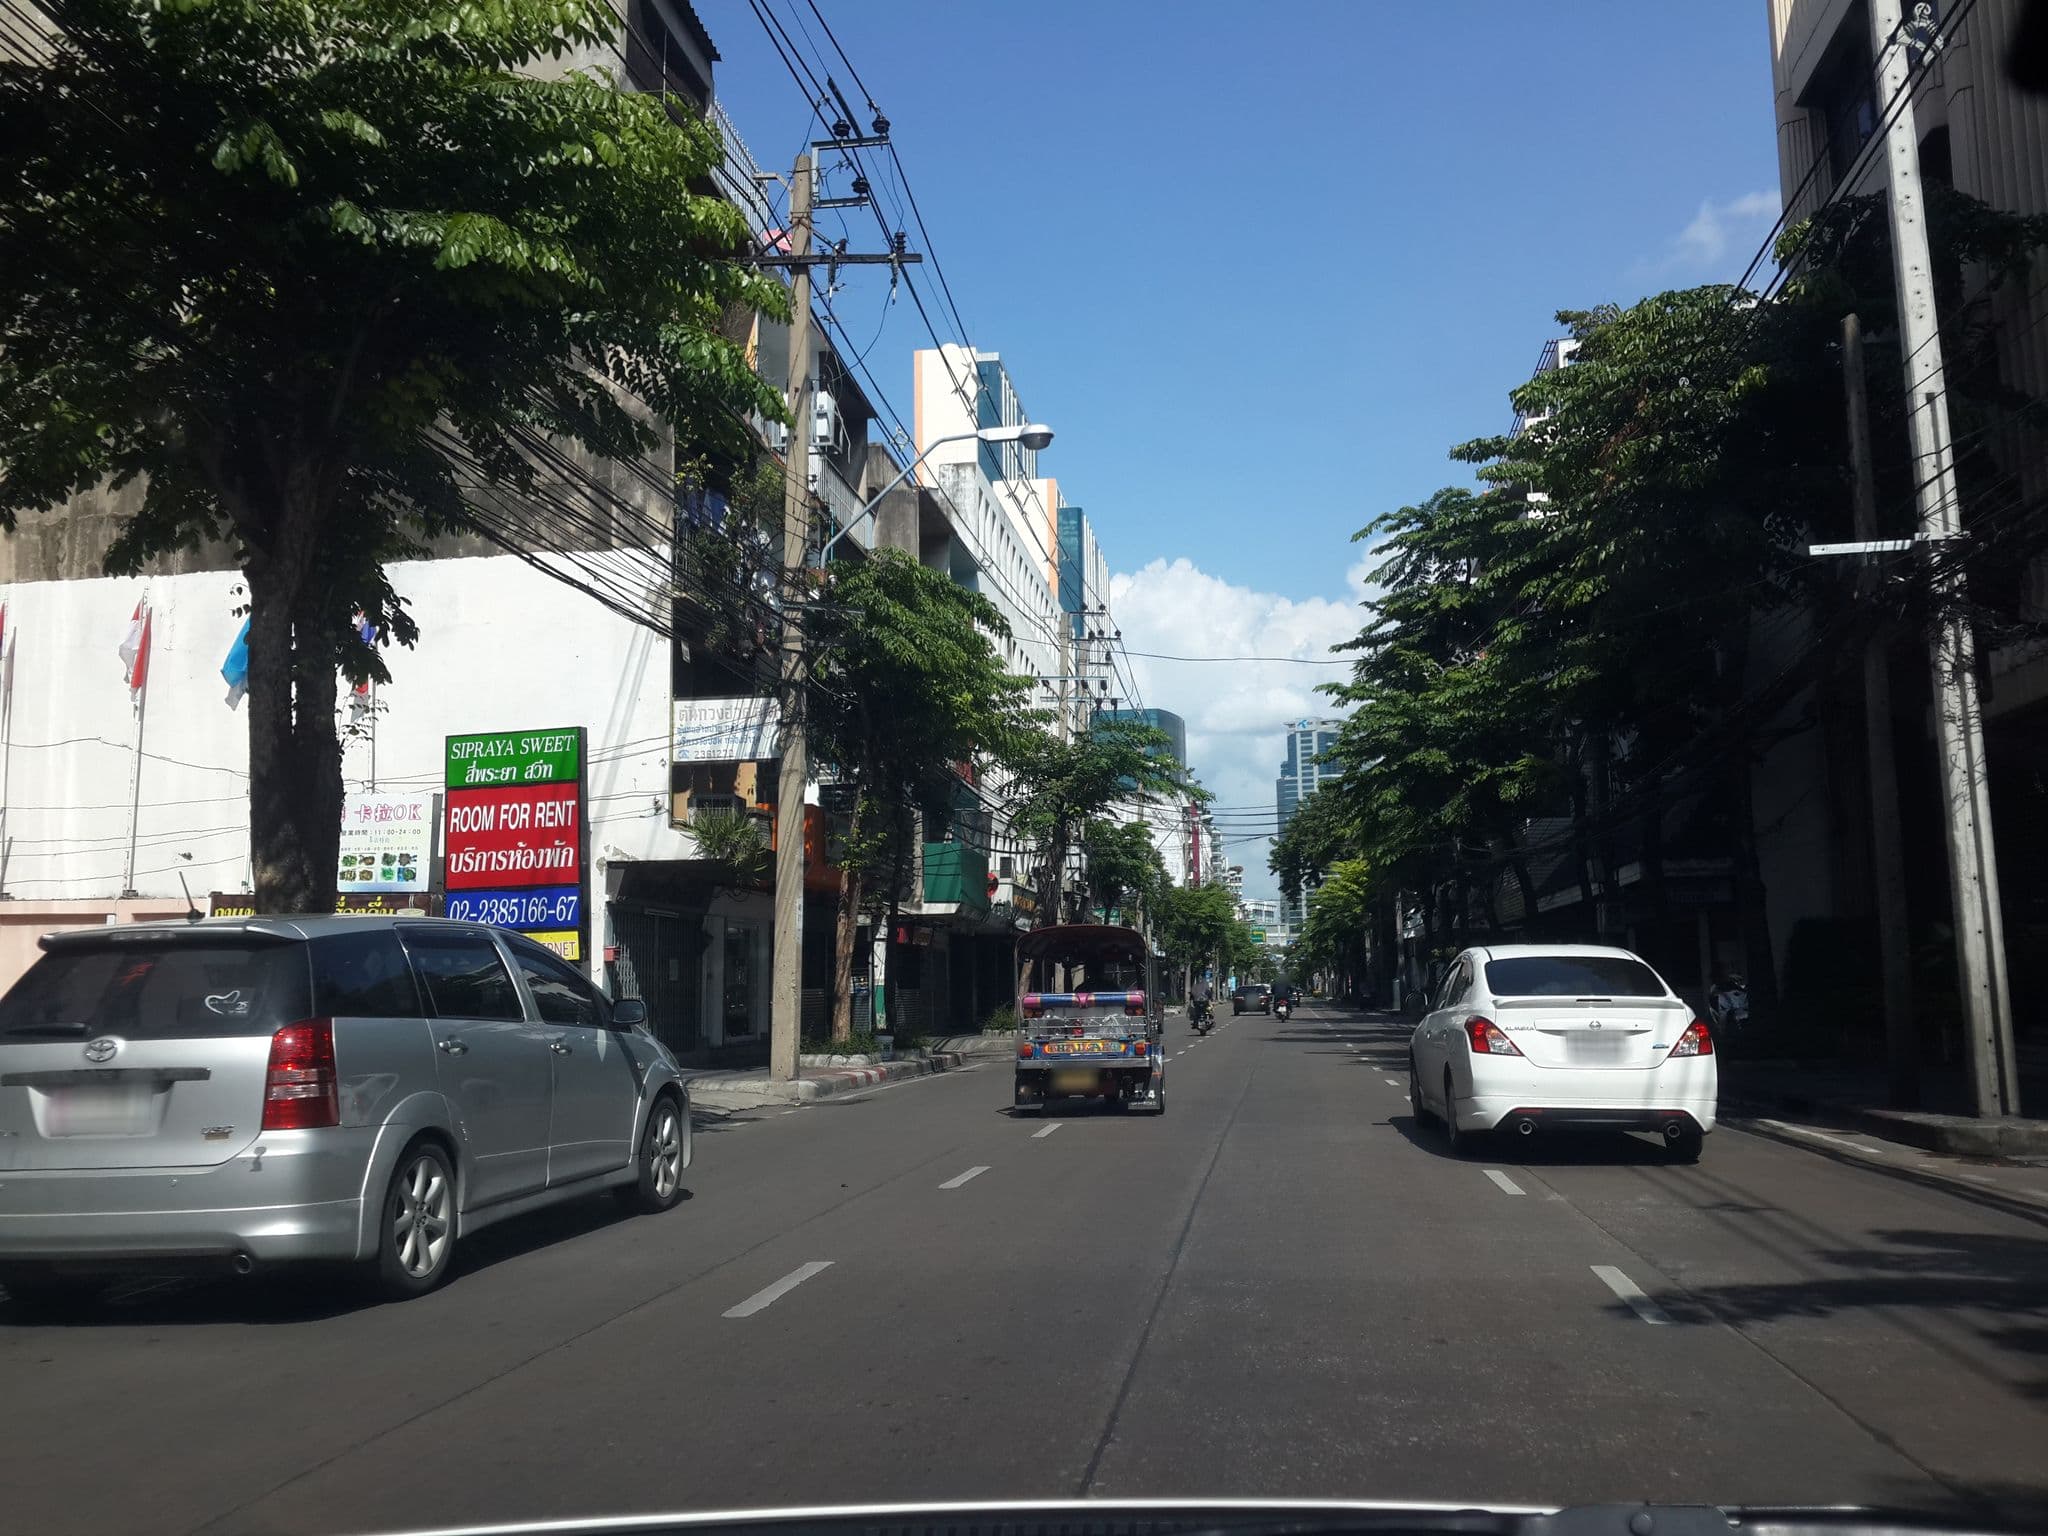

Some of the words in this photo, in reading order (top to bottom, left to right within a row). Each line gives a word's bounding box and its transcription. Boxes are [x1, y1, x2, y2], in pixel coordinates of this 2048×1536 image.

[451, 740, 514, 759] SIPRAYA
[520, 735, 575, 755] SWEET
[465, 760, 517, 783] สี่พระยา
[524, 759, 553, 780] สวีท
[450, 805, 496, 833] ROOM
[499, 803, 531, 830] FOR
[535, 800, 576, 828] RENT
[450, 840, 575, 873] บริการห้องพัก
[450, 896, 578, 924] 02-2385166-67
